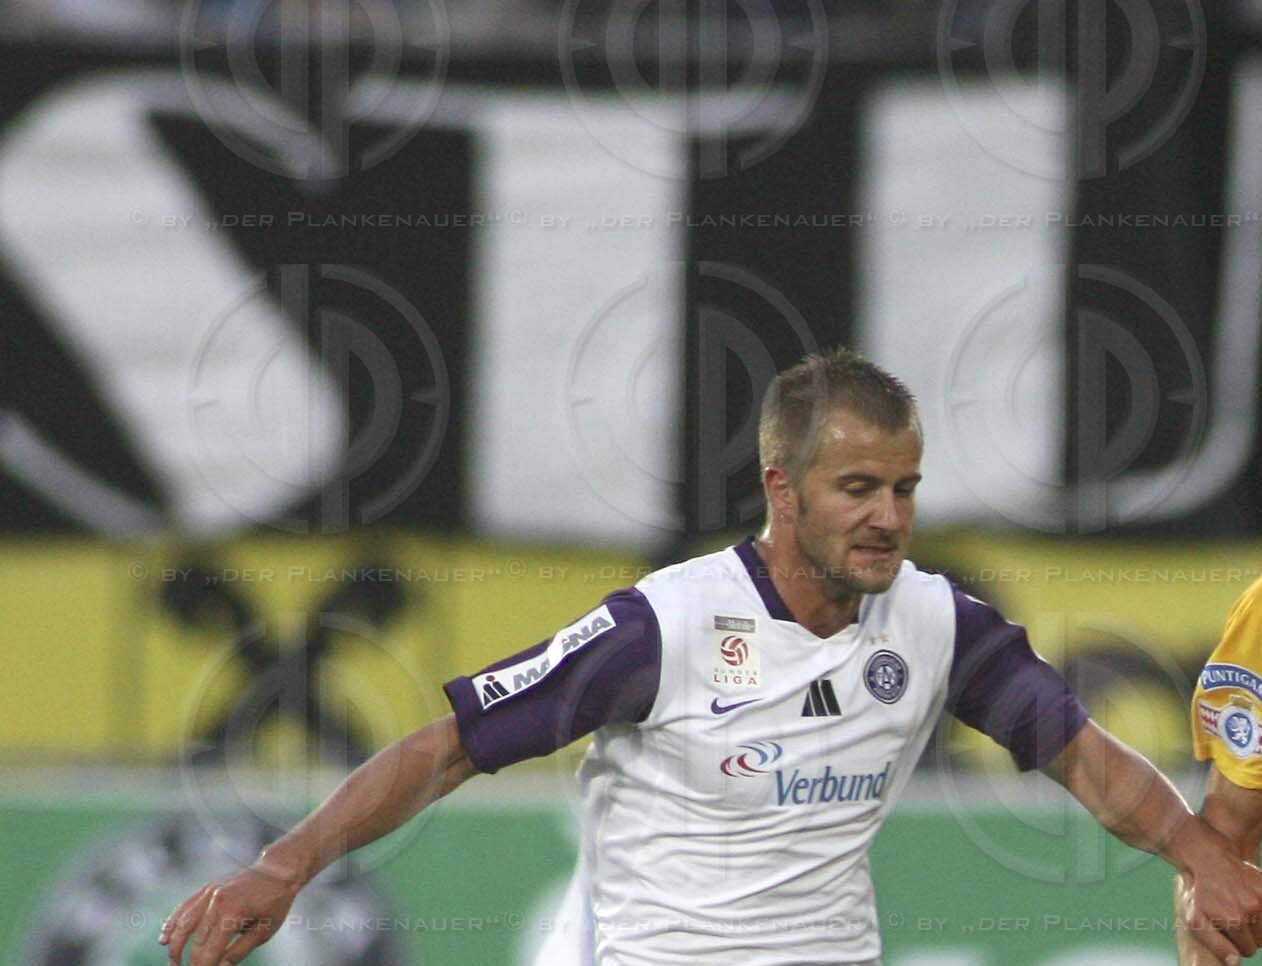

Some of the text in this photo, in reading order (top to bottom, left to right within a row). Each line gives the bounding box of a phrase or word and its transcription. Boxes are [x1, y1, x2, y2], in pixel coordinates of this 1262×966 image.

[511, 615, 612, 692] MANA
[713, 674, 758, 686] LIGA
[775, 760, 893, 806] Verbund
